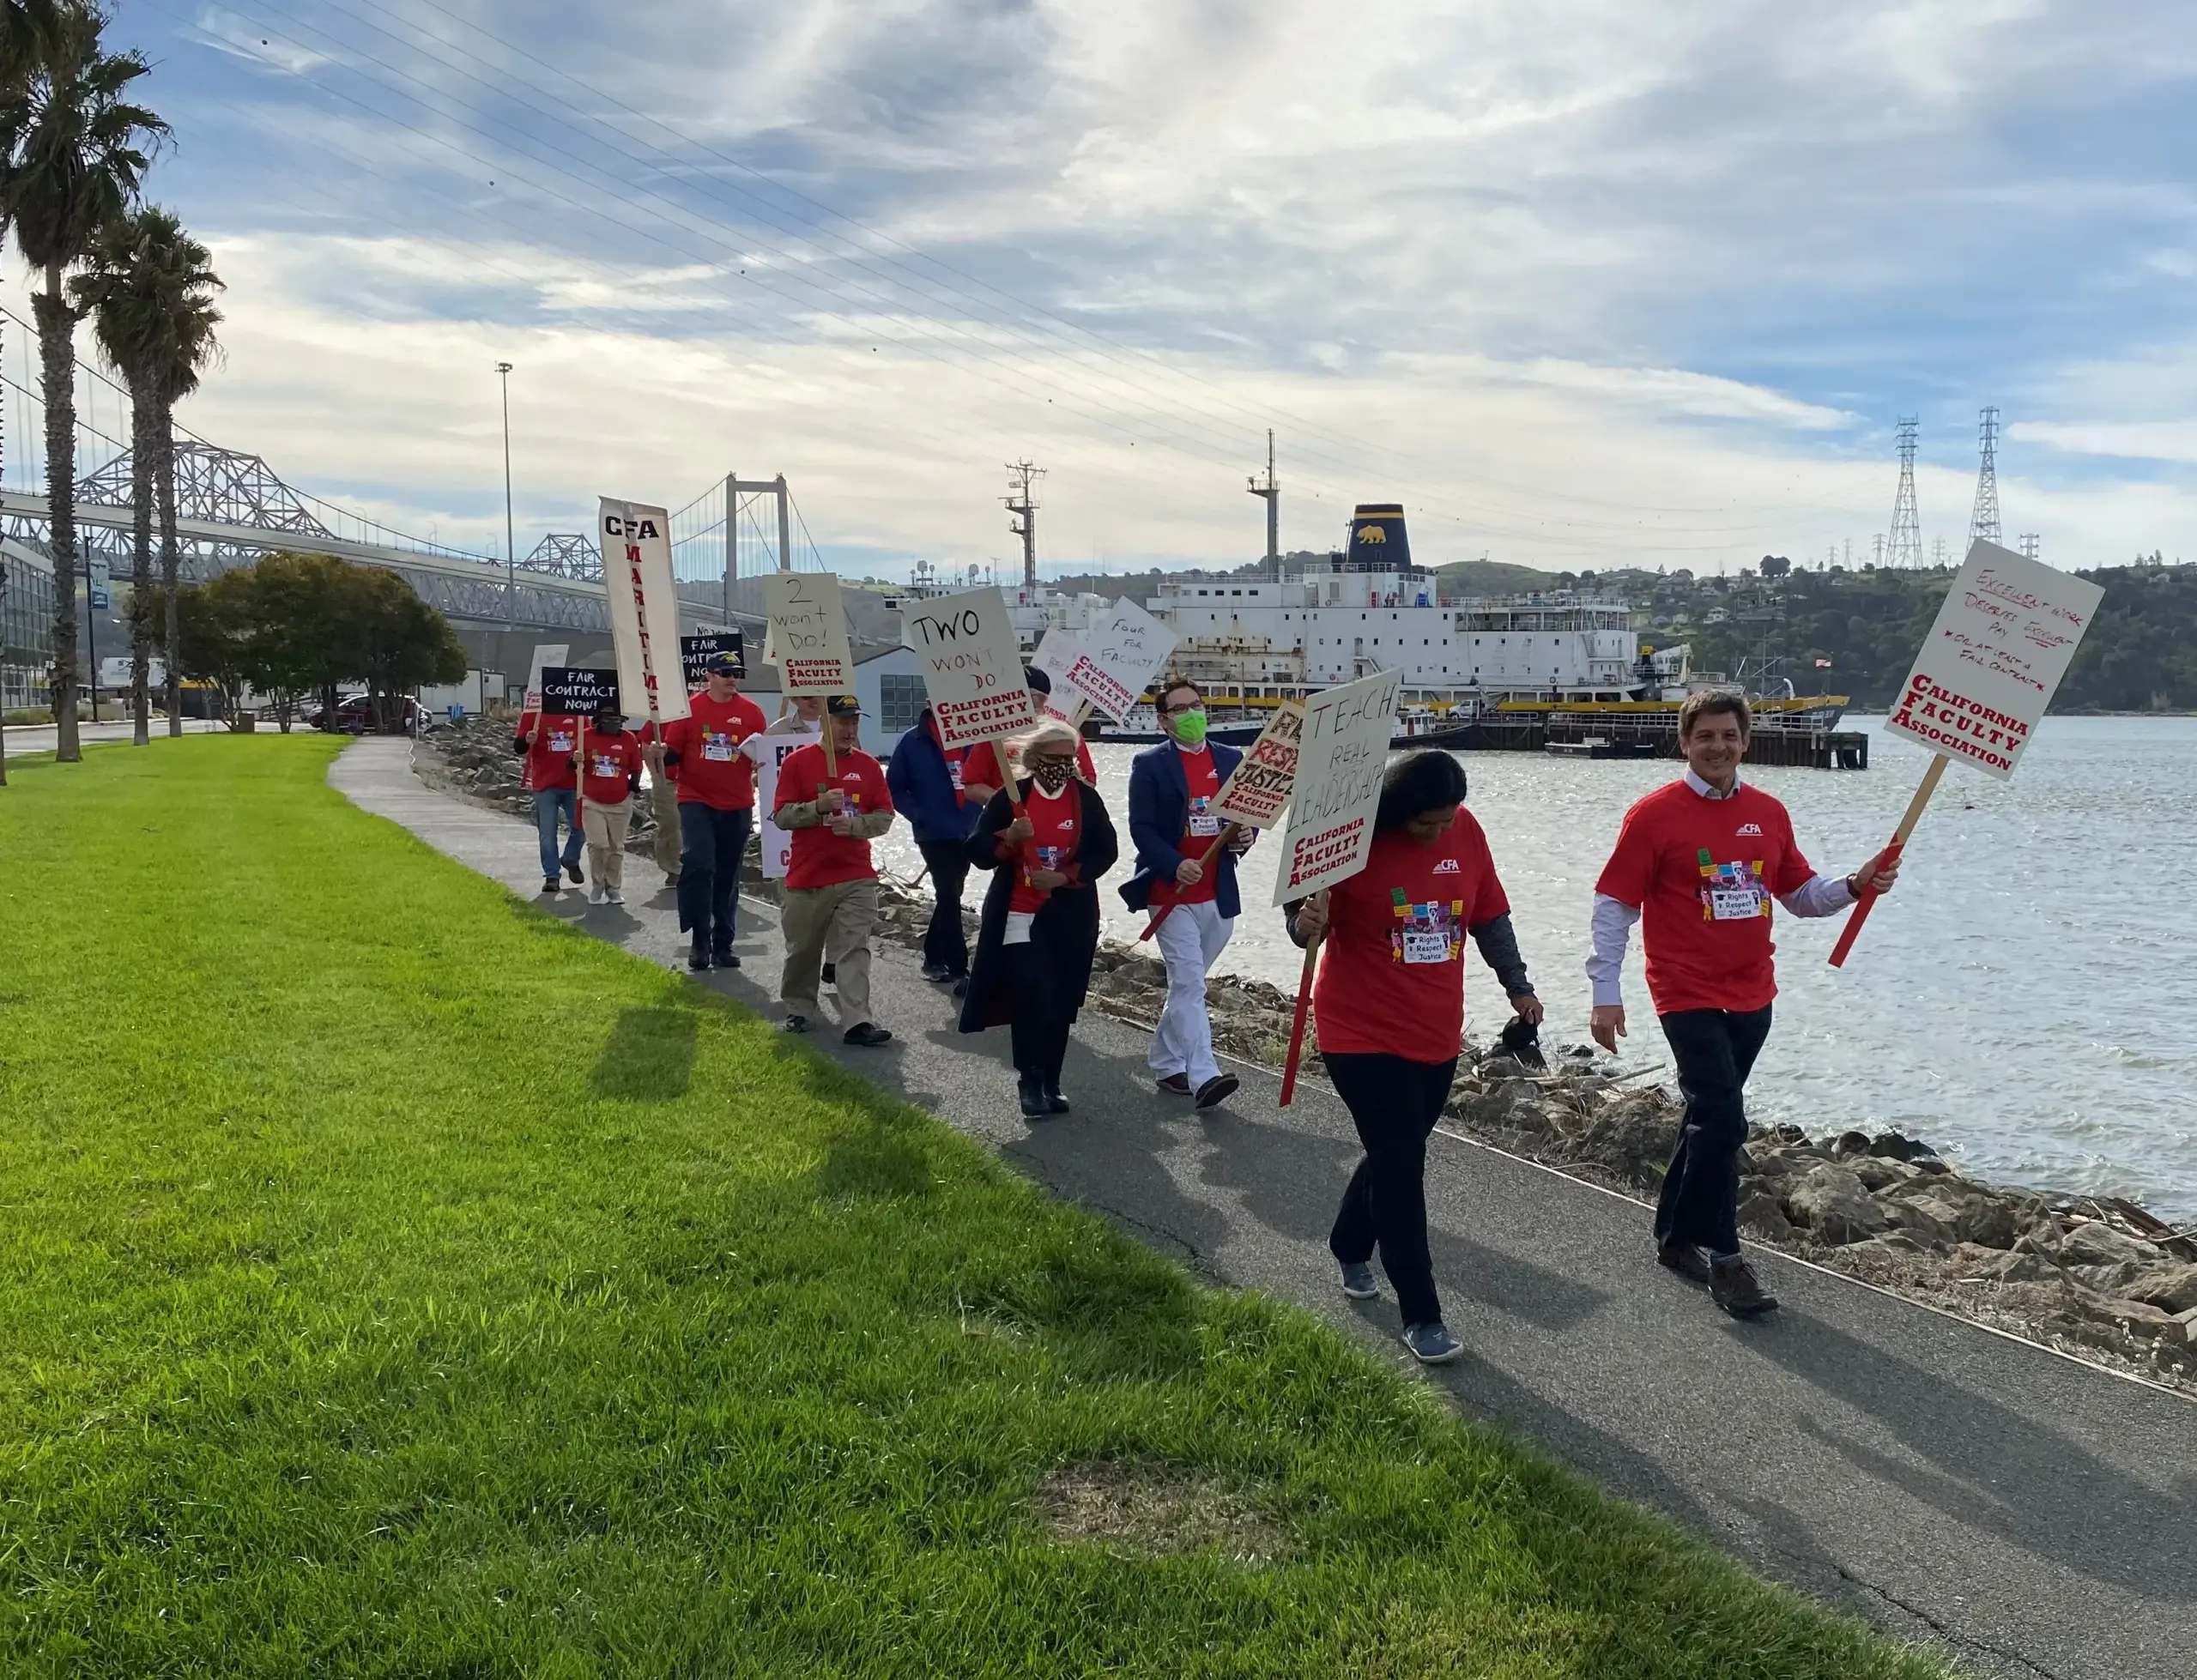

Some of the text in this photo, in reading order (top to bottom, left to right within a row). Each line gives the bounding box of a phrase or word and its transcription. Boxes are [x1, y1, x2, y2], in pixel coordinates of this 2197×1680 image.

[786, 579, 814, 603] 2
[2051, 607, 2084, 627] WORK
[912, 609, 979, 645] TWO
[1988, 621, 2009, 638] PAY
[1123, 638, 1143, 650] FOR
[1959, 650, 1984, 666] FAIR
[567, 672, 595, 683] FAIR
[788, 668, 841, 678] FACULTY
[545, 685, 616, 698] CONTRACT
[1073, 663, 1130, 709] FACULTY
[565, 699, 597, 710] NOW!
[1313, 683, 1396, 739] TEACH
[941, 701, 1027, 728] FACULTY
[1903, 691, 2021, 752] FACULTY
[1329, 739, 1370, 769] REAL
[1226, 791, 1279, 811] FACULTY
[1287, 761, 1386, 834] LEADERSHIP
[1744, 824, 1761, 833] CFA
[1292, 832, 1361, 872] FACULTY
[1441, 859, 1459, 870] CFA
[1728, 892, 1748, 901] Rights
[1416, 944, 1442, 953] Respect
[1419, 935, 1439, 945] Rights
